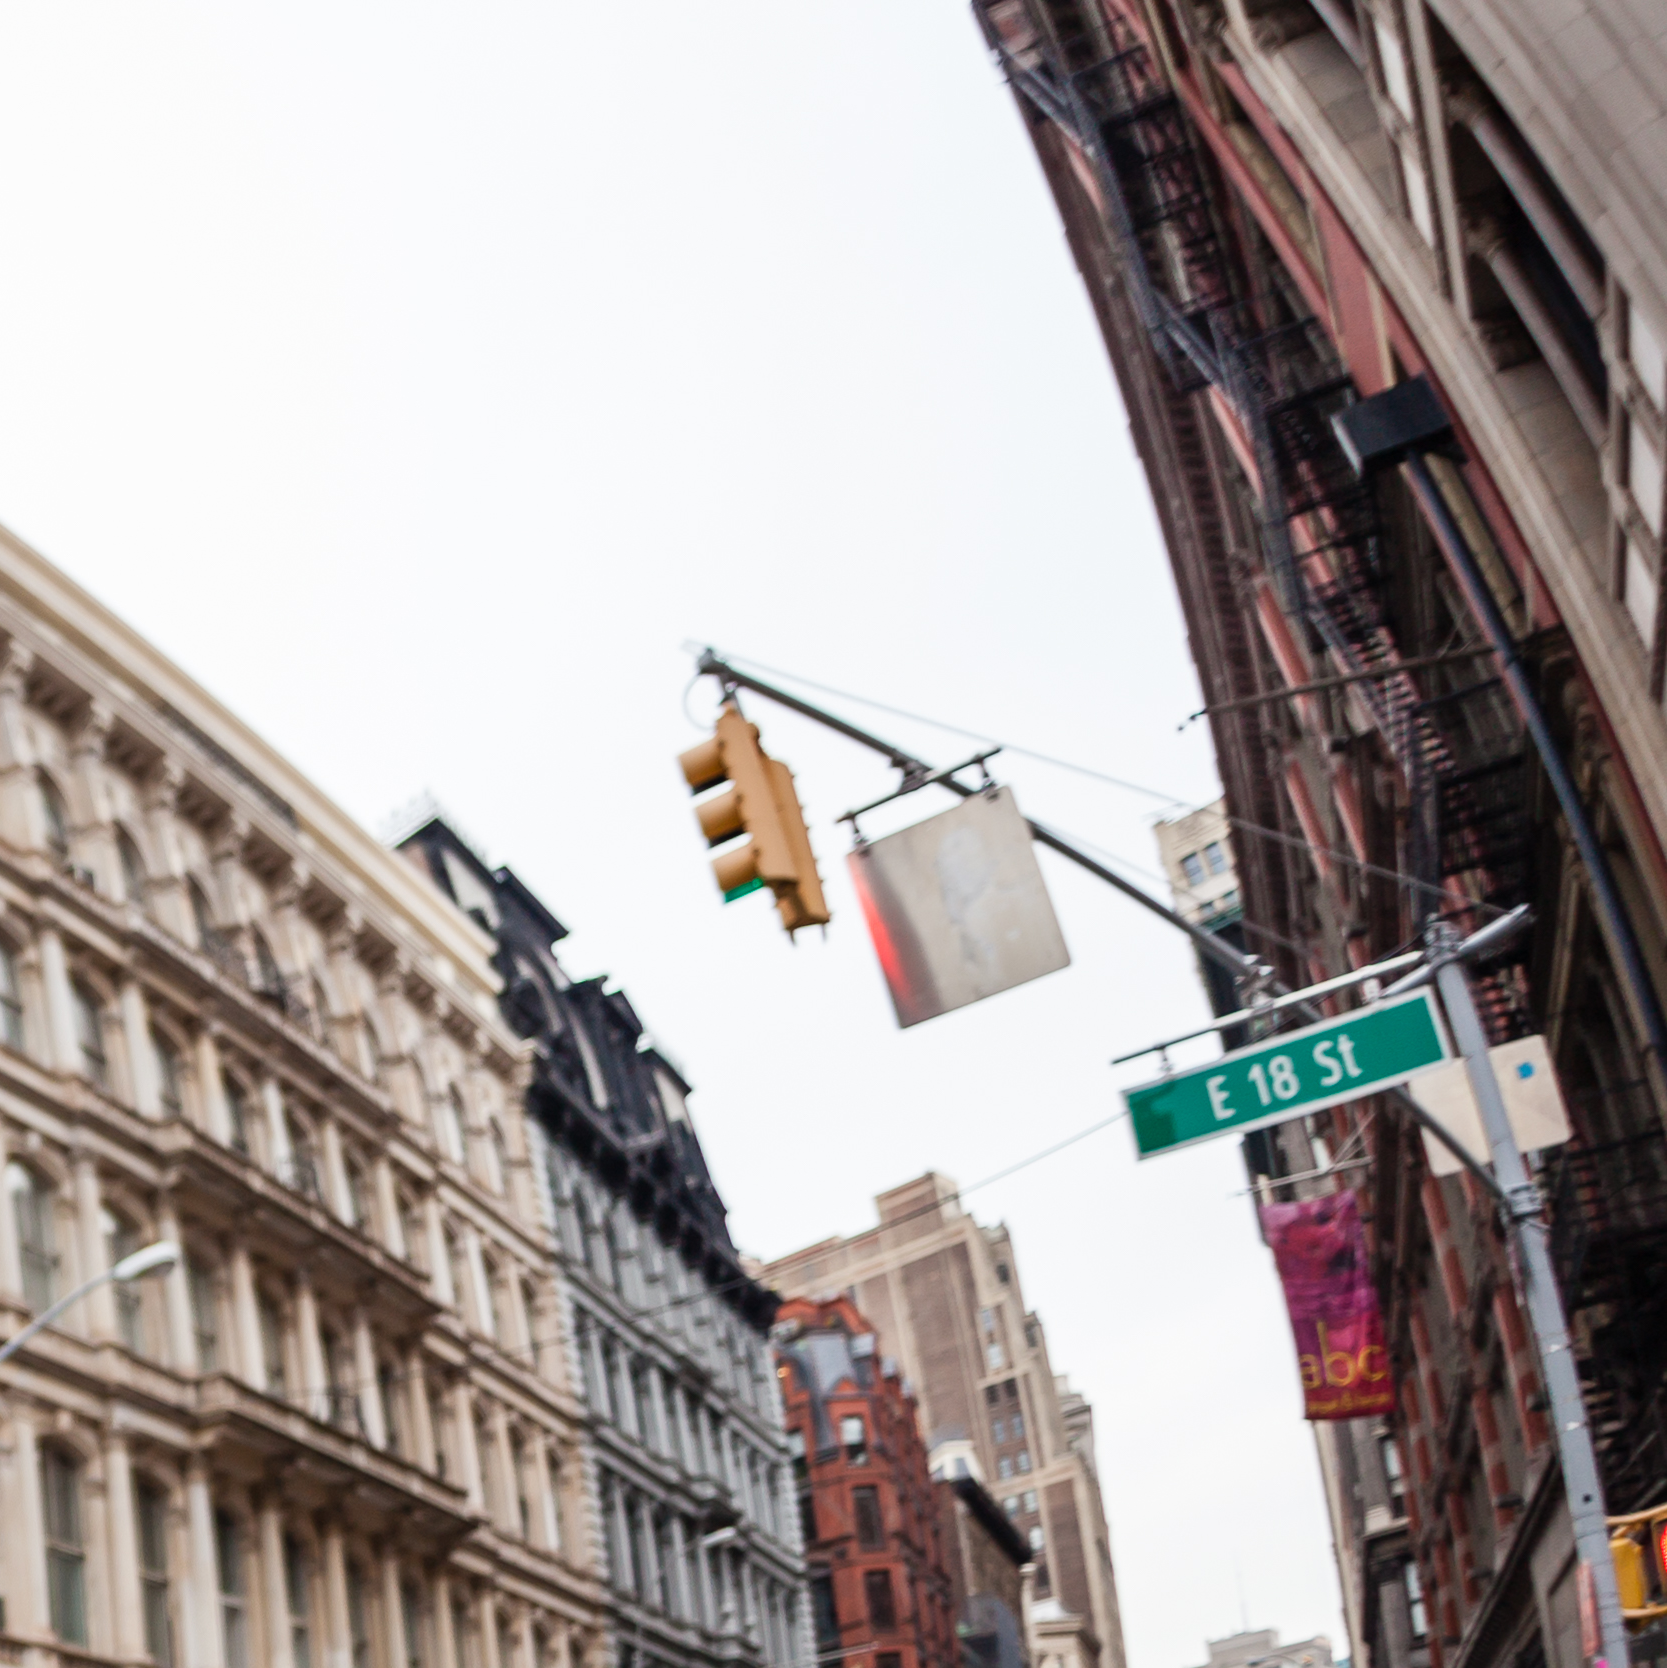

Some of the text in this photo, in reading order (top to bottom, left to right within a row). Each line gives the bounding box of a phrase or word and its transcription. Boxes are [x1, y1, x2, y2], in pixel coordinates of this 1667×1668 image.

[1206, 1033, 1364, 1121] E 18 St
[1299, 1320, 1388, 1389] abc
